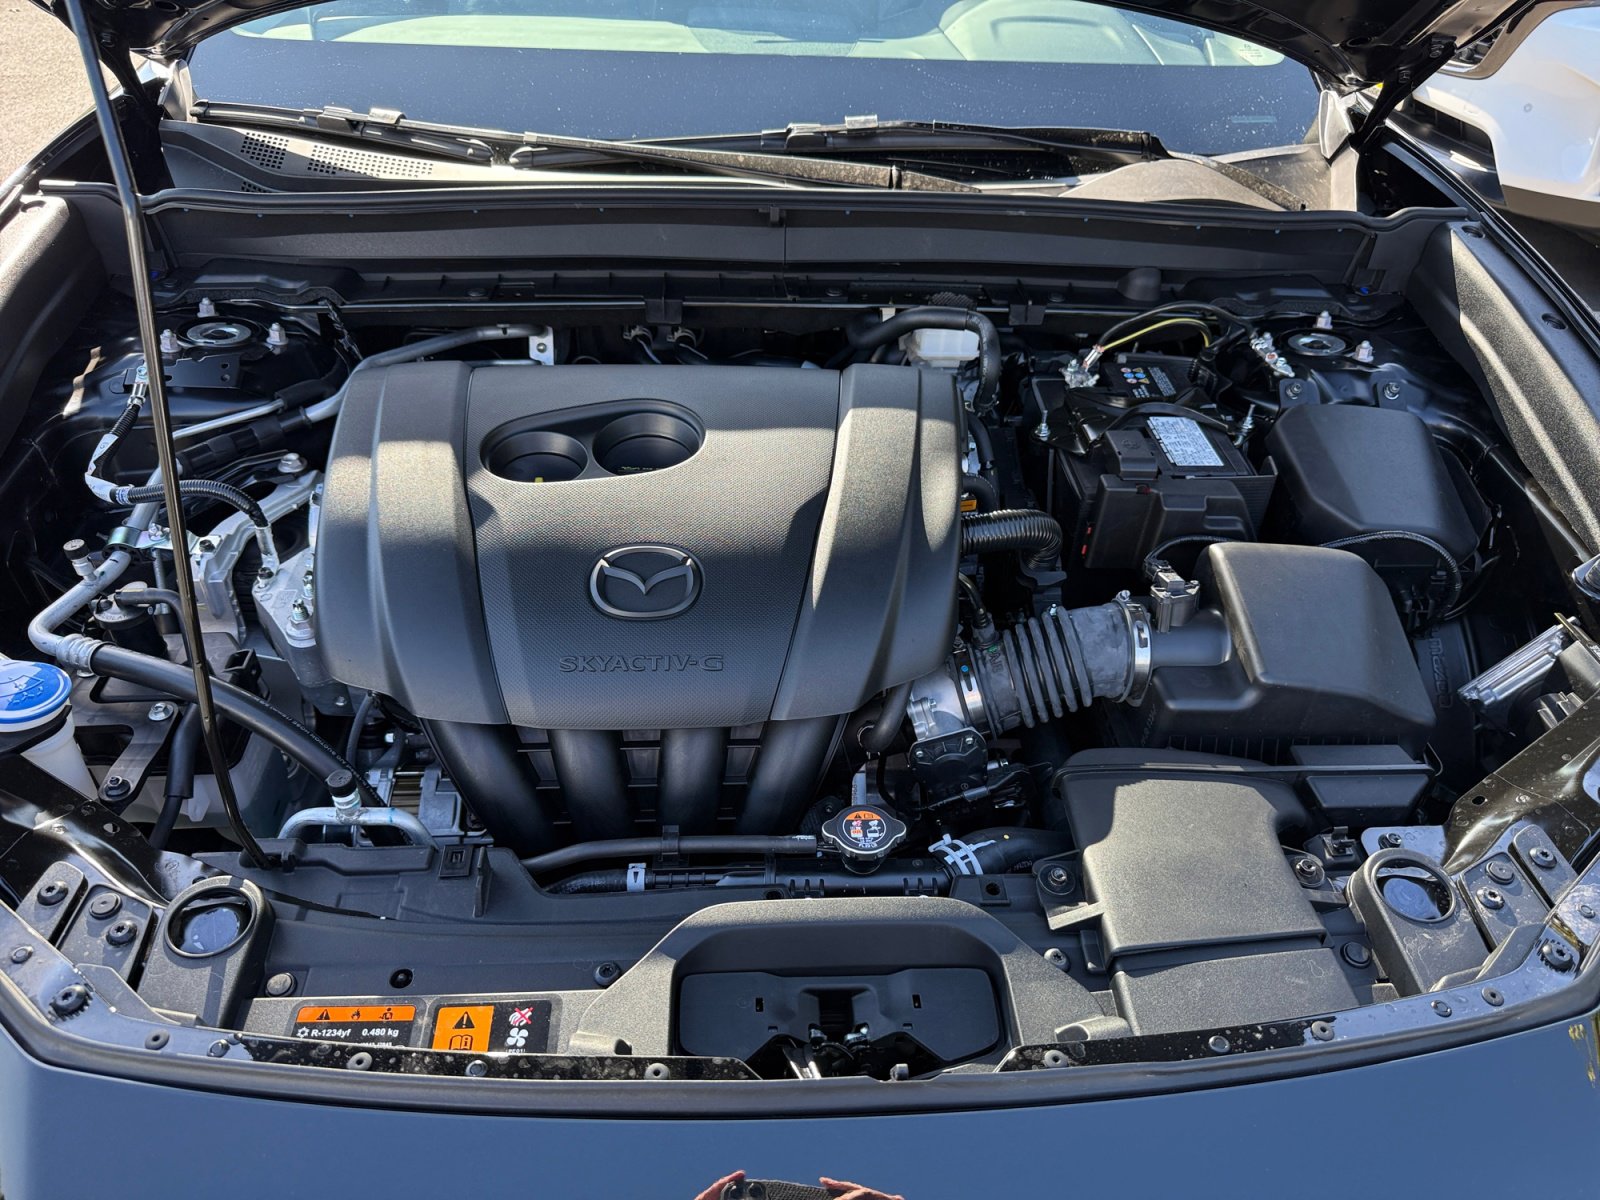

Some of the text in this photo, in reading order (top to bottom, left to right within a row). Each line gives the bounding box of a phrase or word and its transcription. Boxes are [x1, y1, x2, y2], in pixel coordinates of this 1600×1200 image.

[559, 655, 725, 673] SKYACTIV-G
[310, 1028, 399, 1038] R-1234yf 0.480 kg
